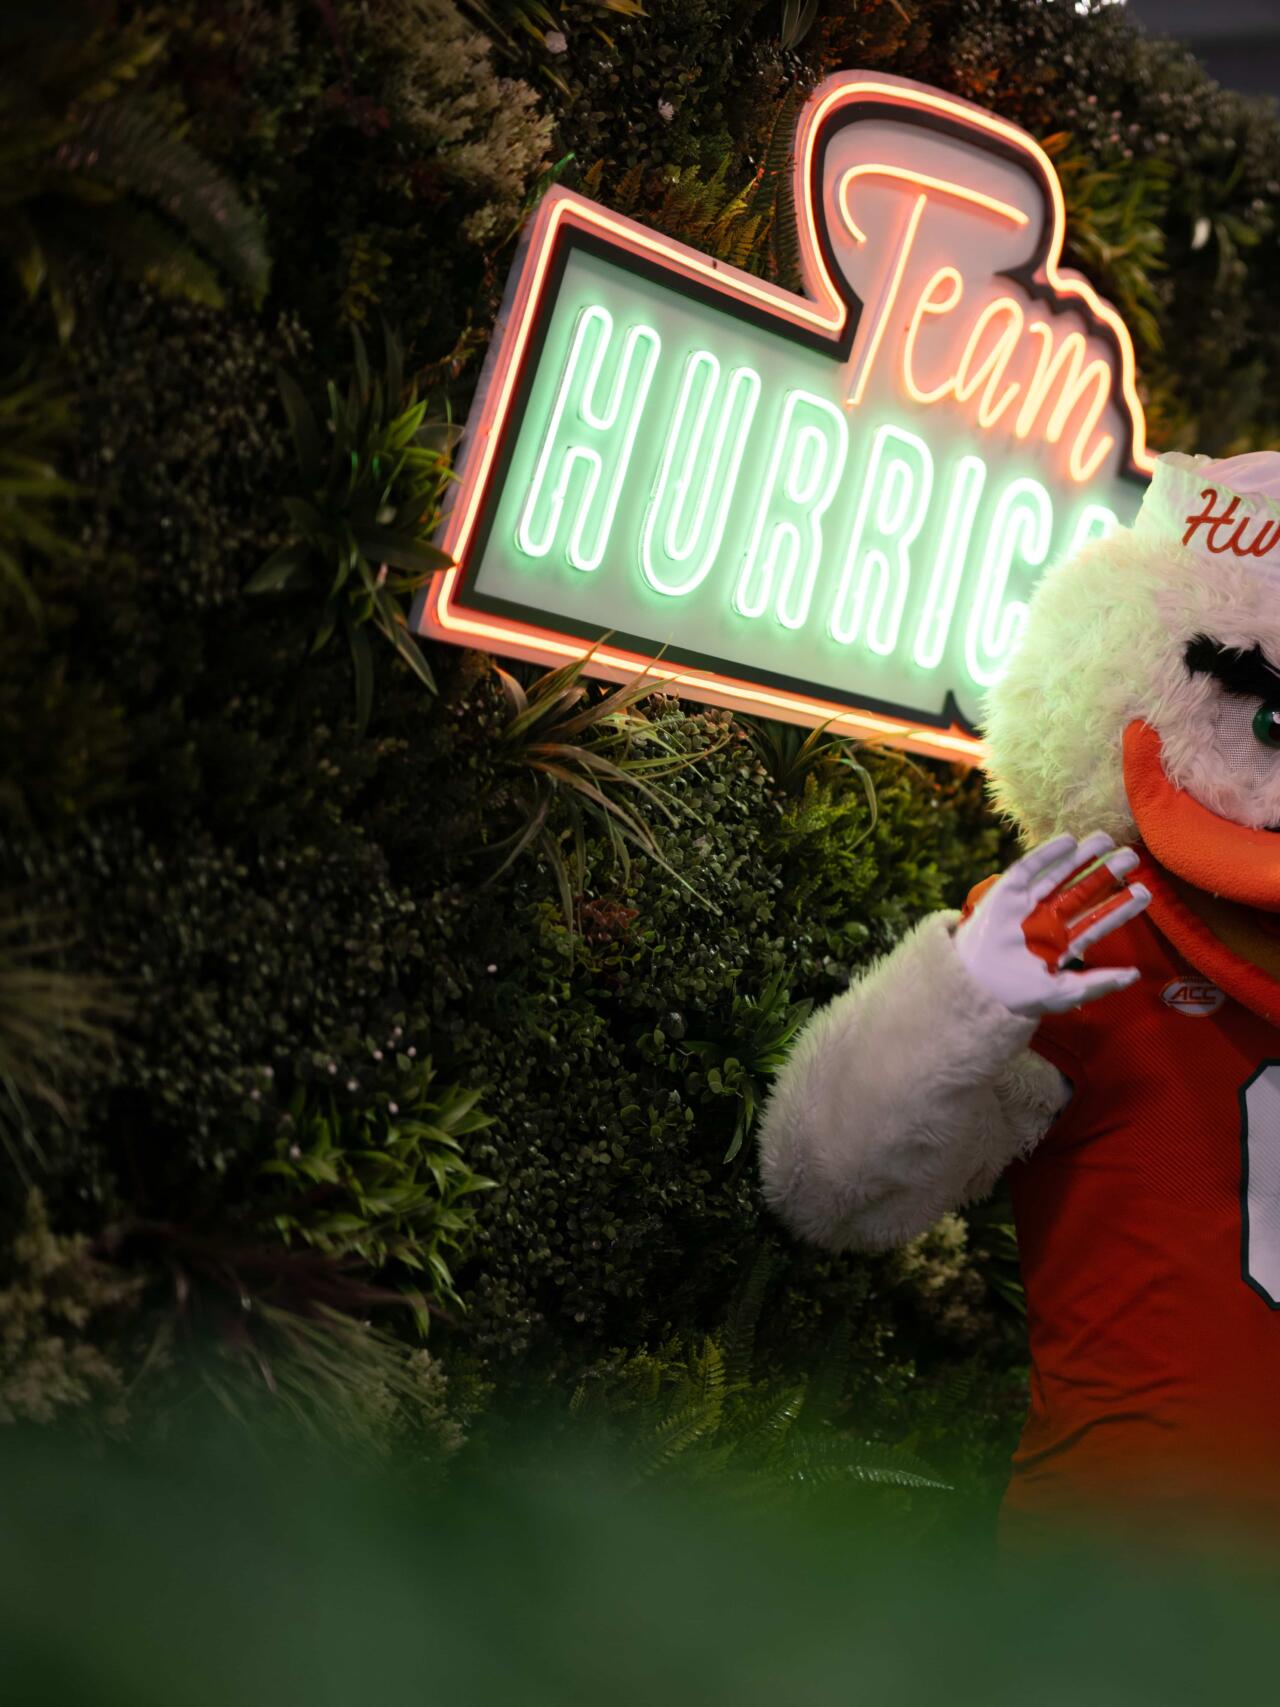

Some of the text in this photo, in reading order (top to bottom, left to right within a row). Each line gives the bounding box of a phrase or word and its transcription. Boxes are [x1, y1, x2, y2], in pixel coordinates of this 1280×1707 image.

[838, 162, 1114, 482] Team
[517, 304, 1119, 687] HURRIC
[1169, 985, 1217, 1001] ACC
